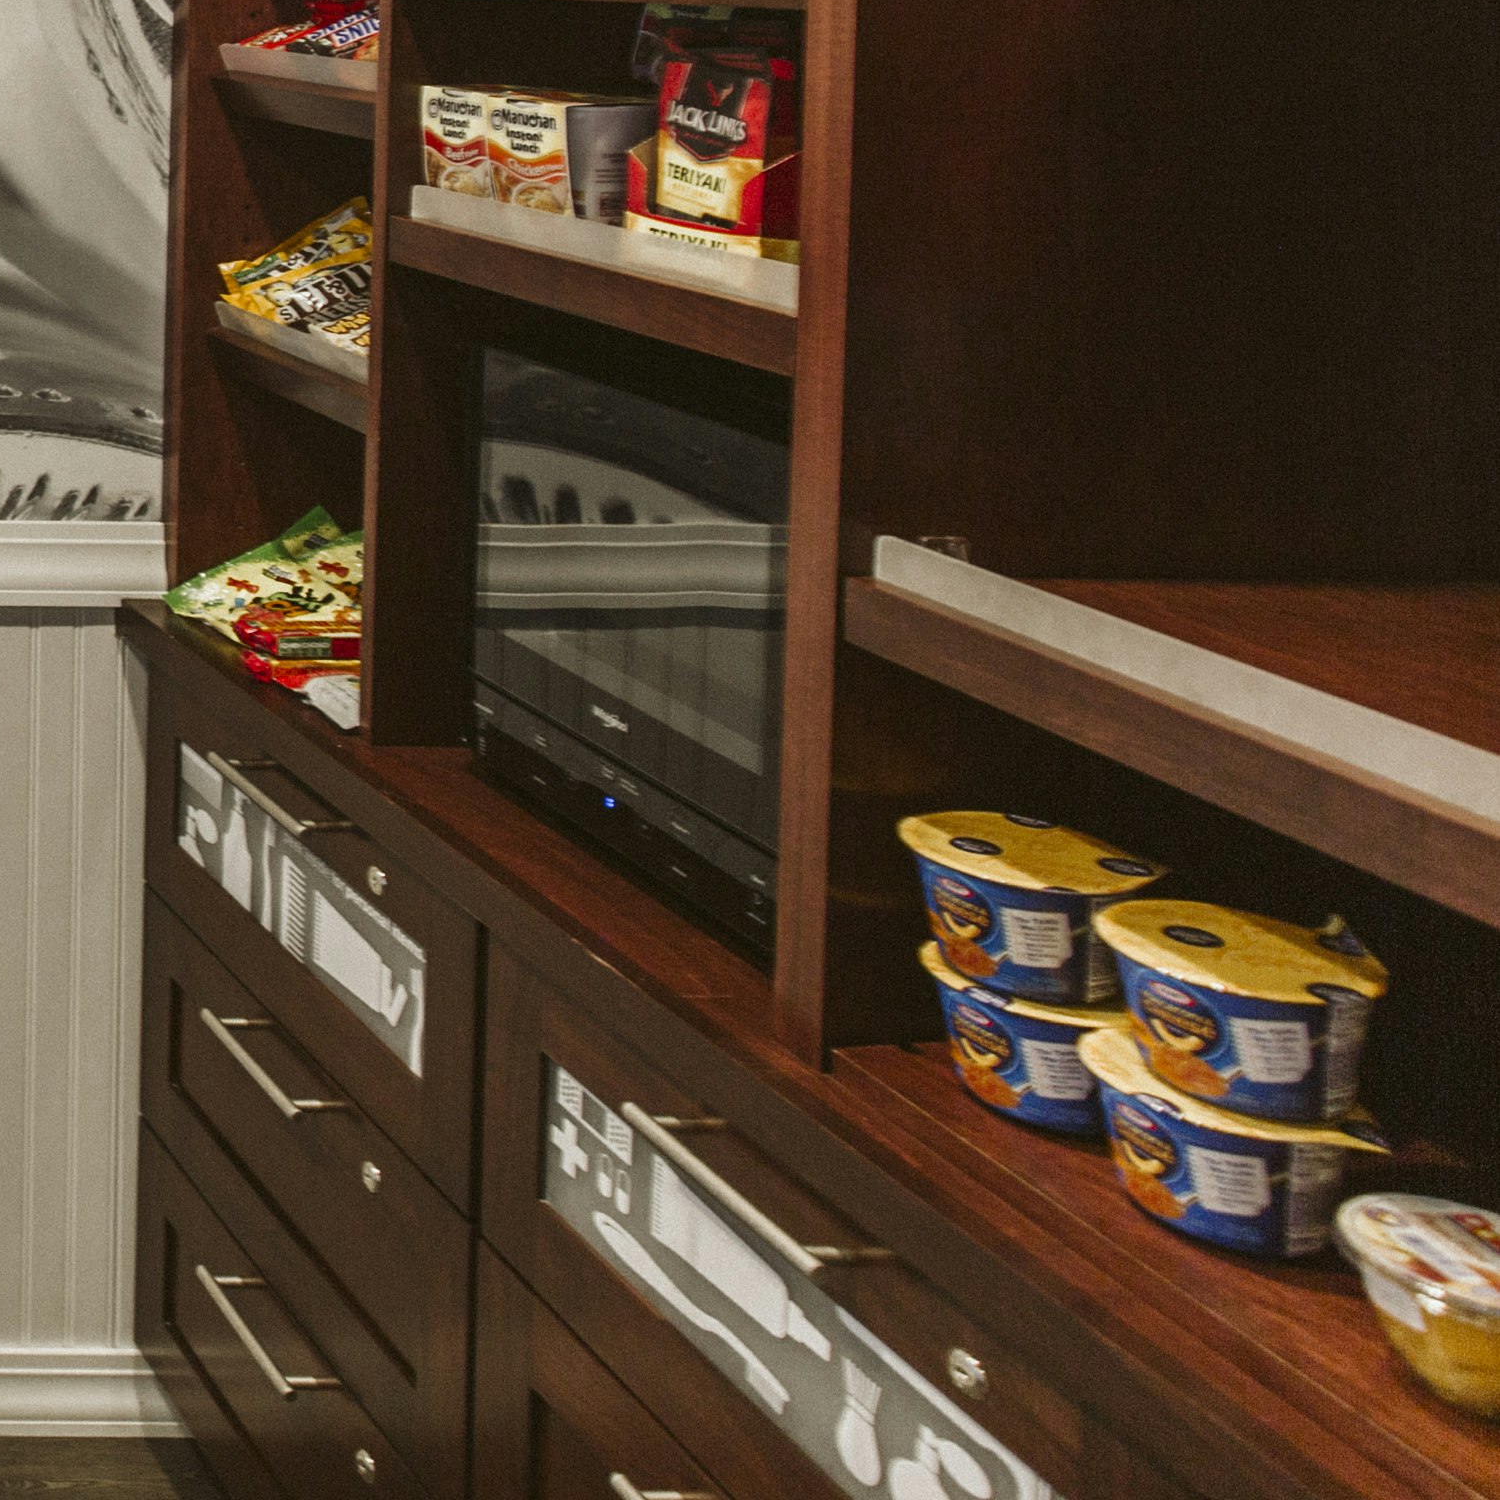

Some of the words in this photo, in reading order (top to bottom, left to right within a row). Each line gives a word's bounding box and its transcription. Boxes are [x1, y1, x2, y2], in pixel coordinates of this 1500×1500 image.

[437, 96, 483, 118] Maruchan
[667, 99, 710, 132] JACK
[439, 114, 470, 129] Instant
[501, 107, 558, 131] Maruchan
[442, 128, 467, 140] Lunch
[505, 128, 544, 143] Instant
[510, 140, 541, 154] Lunch
[666, 162, 728, 195] TERIYAKI
